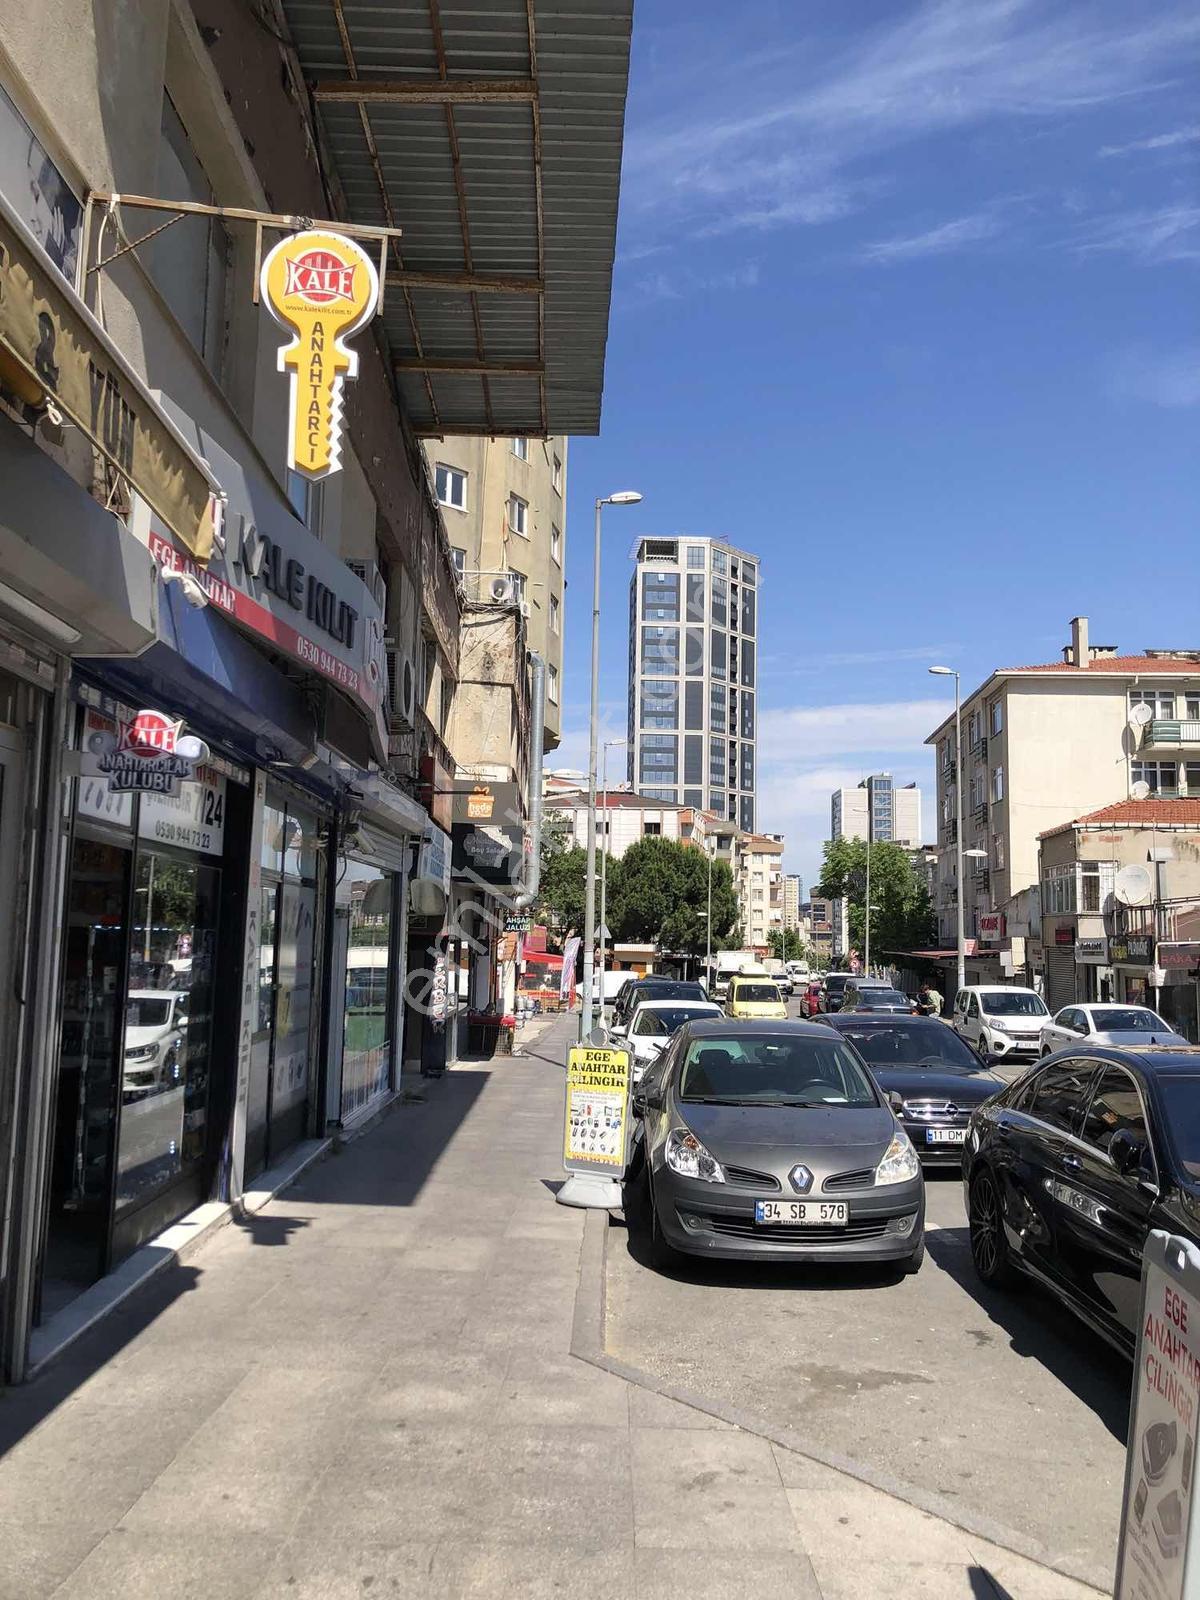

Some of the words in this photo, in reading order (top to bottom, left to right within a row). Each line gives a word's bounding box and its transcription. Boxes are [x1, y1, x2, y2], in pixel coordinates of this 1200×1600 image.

[288, 262, 353, 300] KALE
[307, 321, 325, 462] ANAHTARCI
[226, 512, 305, 611] KALE
[297, 636, 320, 665] 0530
[320, 651, 336, 678] 944
[120, 727, 174, 753] KALE
[571, 1062, 626, 1075] ANAHTAR
[585, 1051, 611, 1062] EGE
[933, 1130, 943, 1141] 11
[948, 1130, 963, 1141] DM
[764, 1203, 781, 1218] 34
[790, 1203, 806, 1219] SB
[820, 1204, 845, 1219] 578
[1165, 1286, 1188, 1335] EGE
